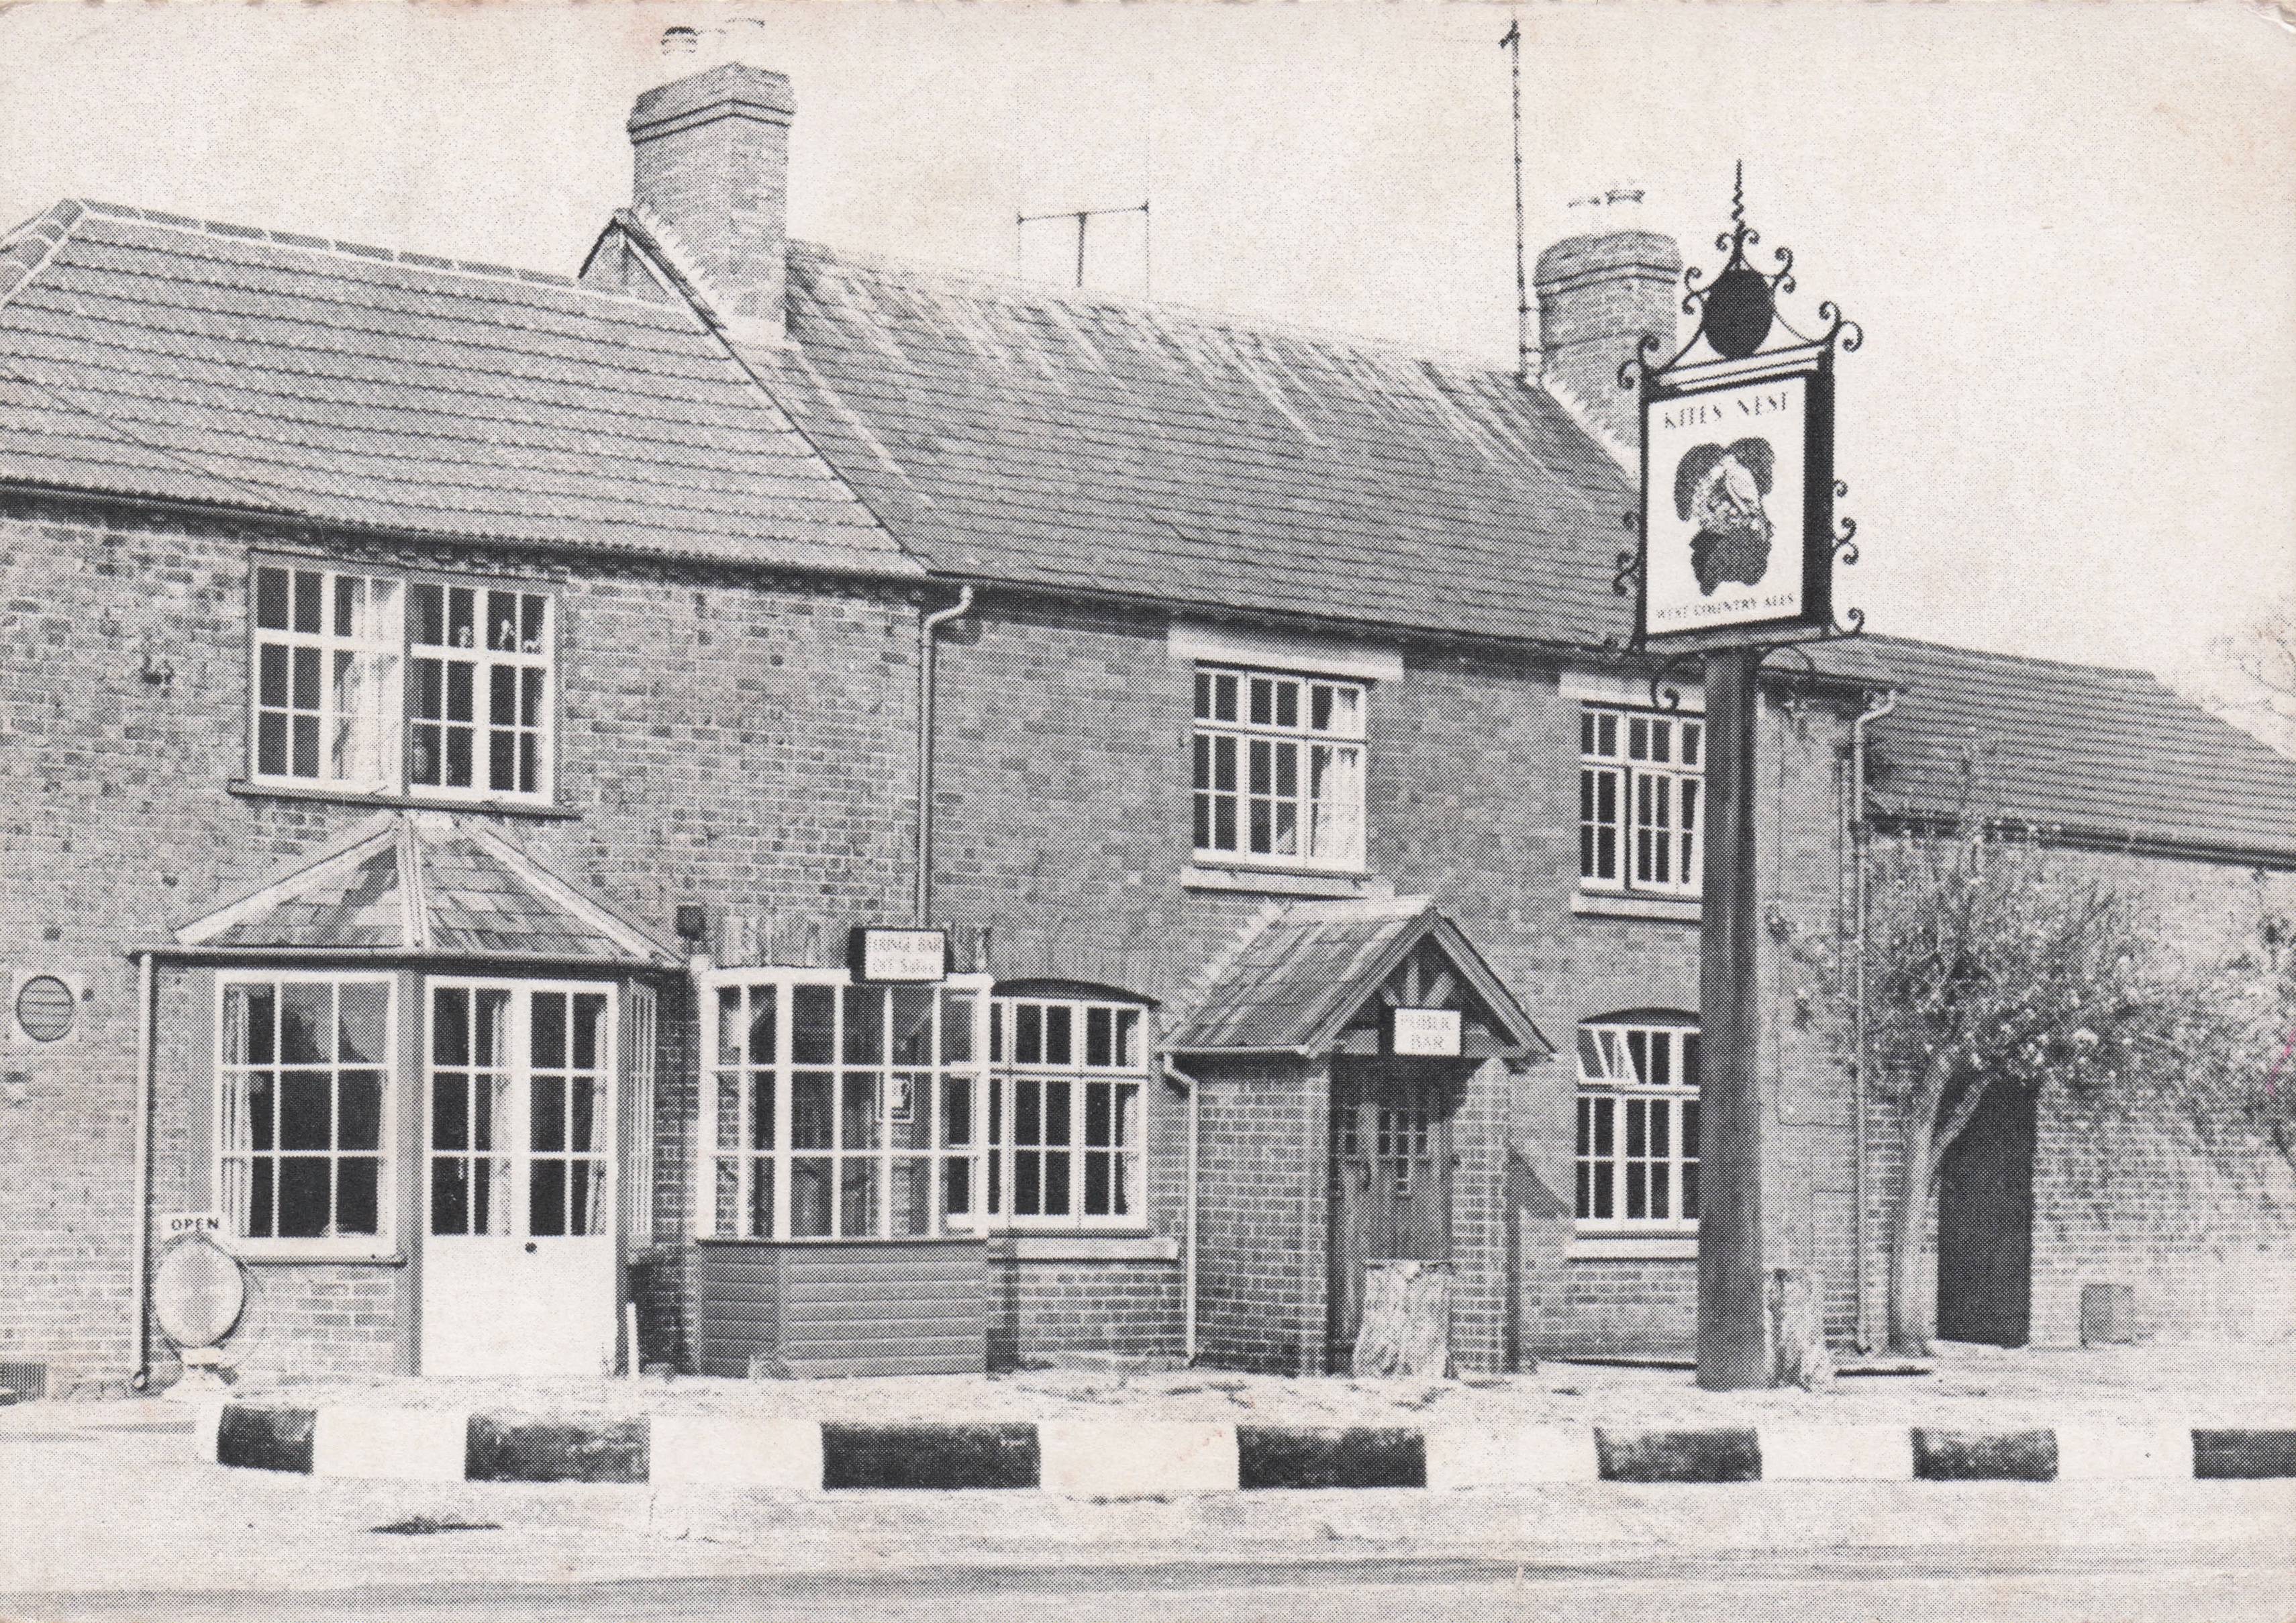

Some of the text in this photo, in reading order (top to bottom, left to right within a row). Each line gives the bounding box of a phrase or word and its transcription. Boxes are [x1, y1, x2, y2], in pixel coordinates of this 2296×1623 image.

[1664, 391, 1789, 430] KITES NEST
[1411, 1034, 1444, 1050] BAR
[171, 1218, 219, 1230] OPEN
